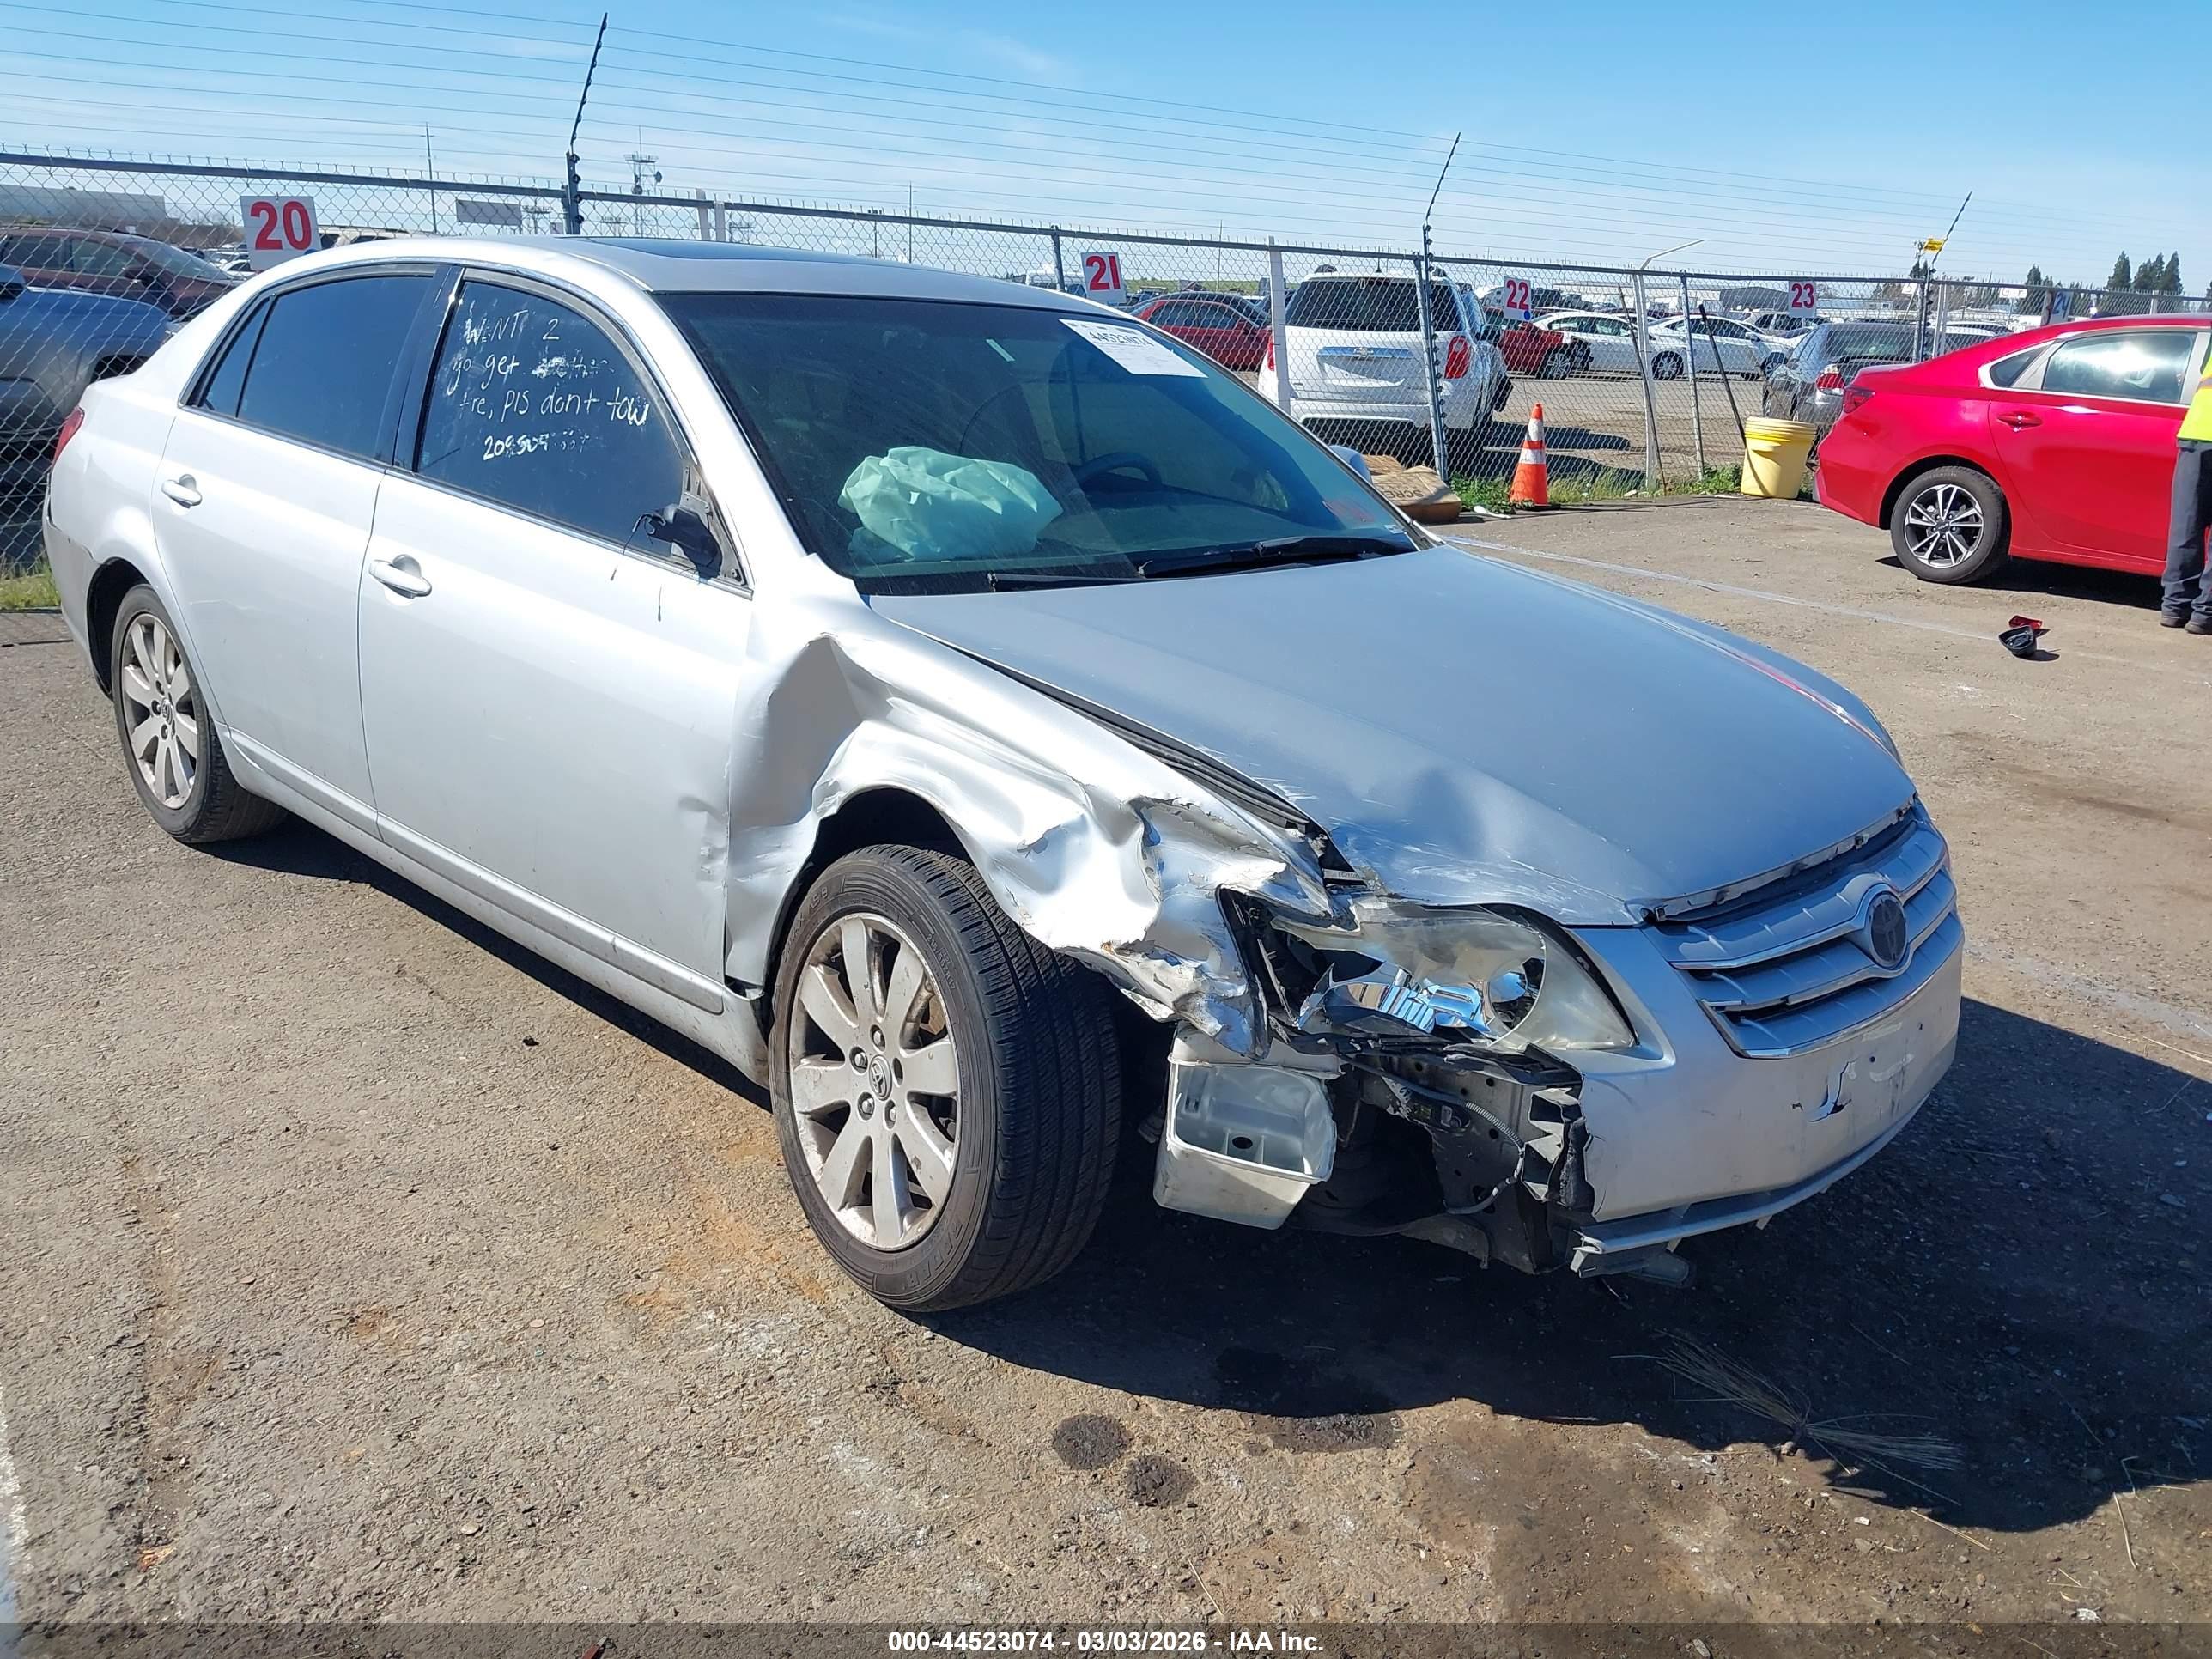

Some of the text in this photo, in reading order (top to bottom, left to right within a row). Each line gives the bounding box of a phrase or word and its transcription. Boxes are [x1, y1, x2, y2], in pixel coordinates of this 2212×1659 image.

[251, 200, 312, 250] 20
[1085, 255, 1121, 290] 21
[1506, 279, 1529, 310] 22
[1791, 283, 1815, 308] 23
[542, 318, 560, 341] 2
[481, 353, 520, 390] get
[540, 386, 600, 416] dont
[606, 386, 650, 427] tow
[1382, 489, 1424, 499] SCRE
